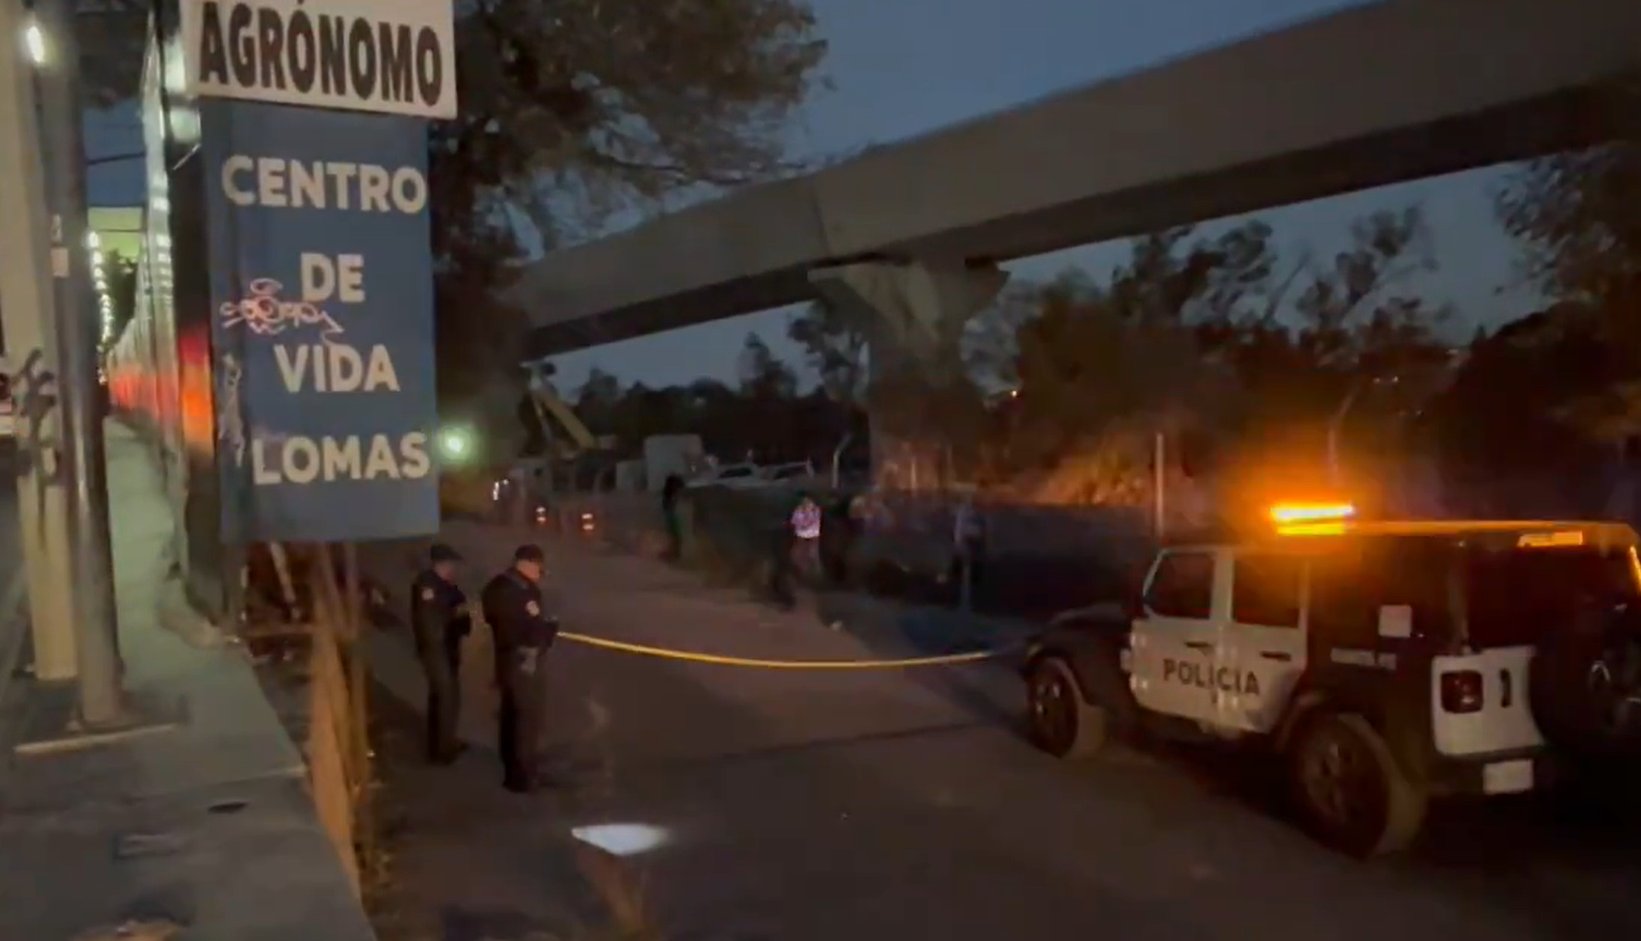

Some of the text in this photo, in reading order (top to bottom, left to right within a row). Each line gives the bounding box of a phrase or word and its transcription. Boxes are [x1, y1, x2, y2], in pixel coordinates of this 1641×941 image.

[200, 0, 442, 106] AGRÓNOMO
[222, 155, 427, 214] CENTRO
[301, 252, 366, 302] DE
[273, 343, 401, 393] VIDA
[252, 432, 431, 485] LOMAS
[1163, 658, 1260, 696] POLICIA
